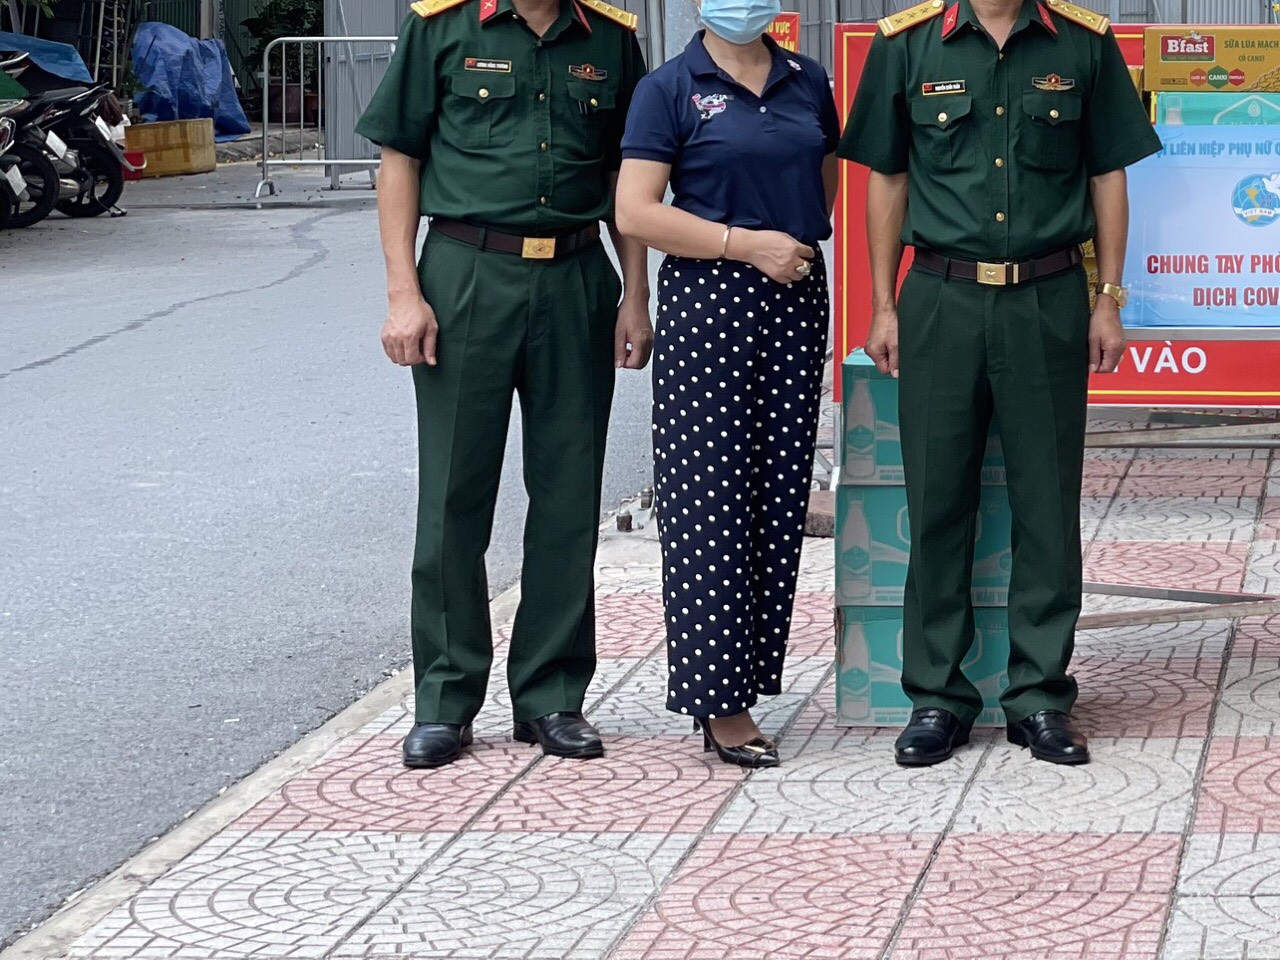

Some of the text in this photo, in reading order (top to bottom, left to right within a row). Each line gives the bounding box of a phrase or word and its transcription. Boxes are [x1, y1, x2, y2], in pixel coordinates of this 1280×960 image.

[775, 20, 791, 36] VỰC
[1167, 39, 1209, 53] B'fast
[1224, 39, 1240, 49] SỮA
[1257, 40, 1279, 51] MẠCH
[1169, 140, 1196, 155] LIÊN
[1198, 141, 1225, 158] HIỆP
[1228, 141, 1250, 158] PHỤ
[1255, 139, 1274, 155] NỮ
[1146, 254, 1210, 274] CHUNG
[1215, 254, 1244, 274] TAY
[1193, 287, 1237, 310] DỊCH
[1129, 340, 1207, 374] VÀO
